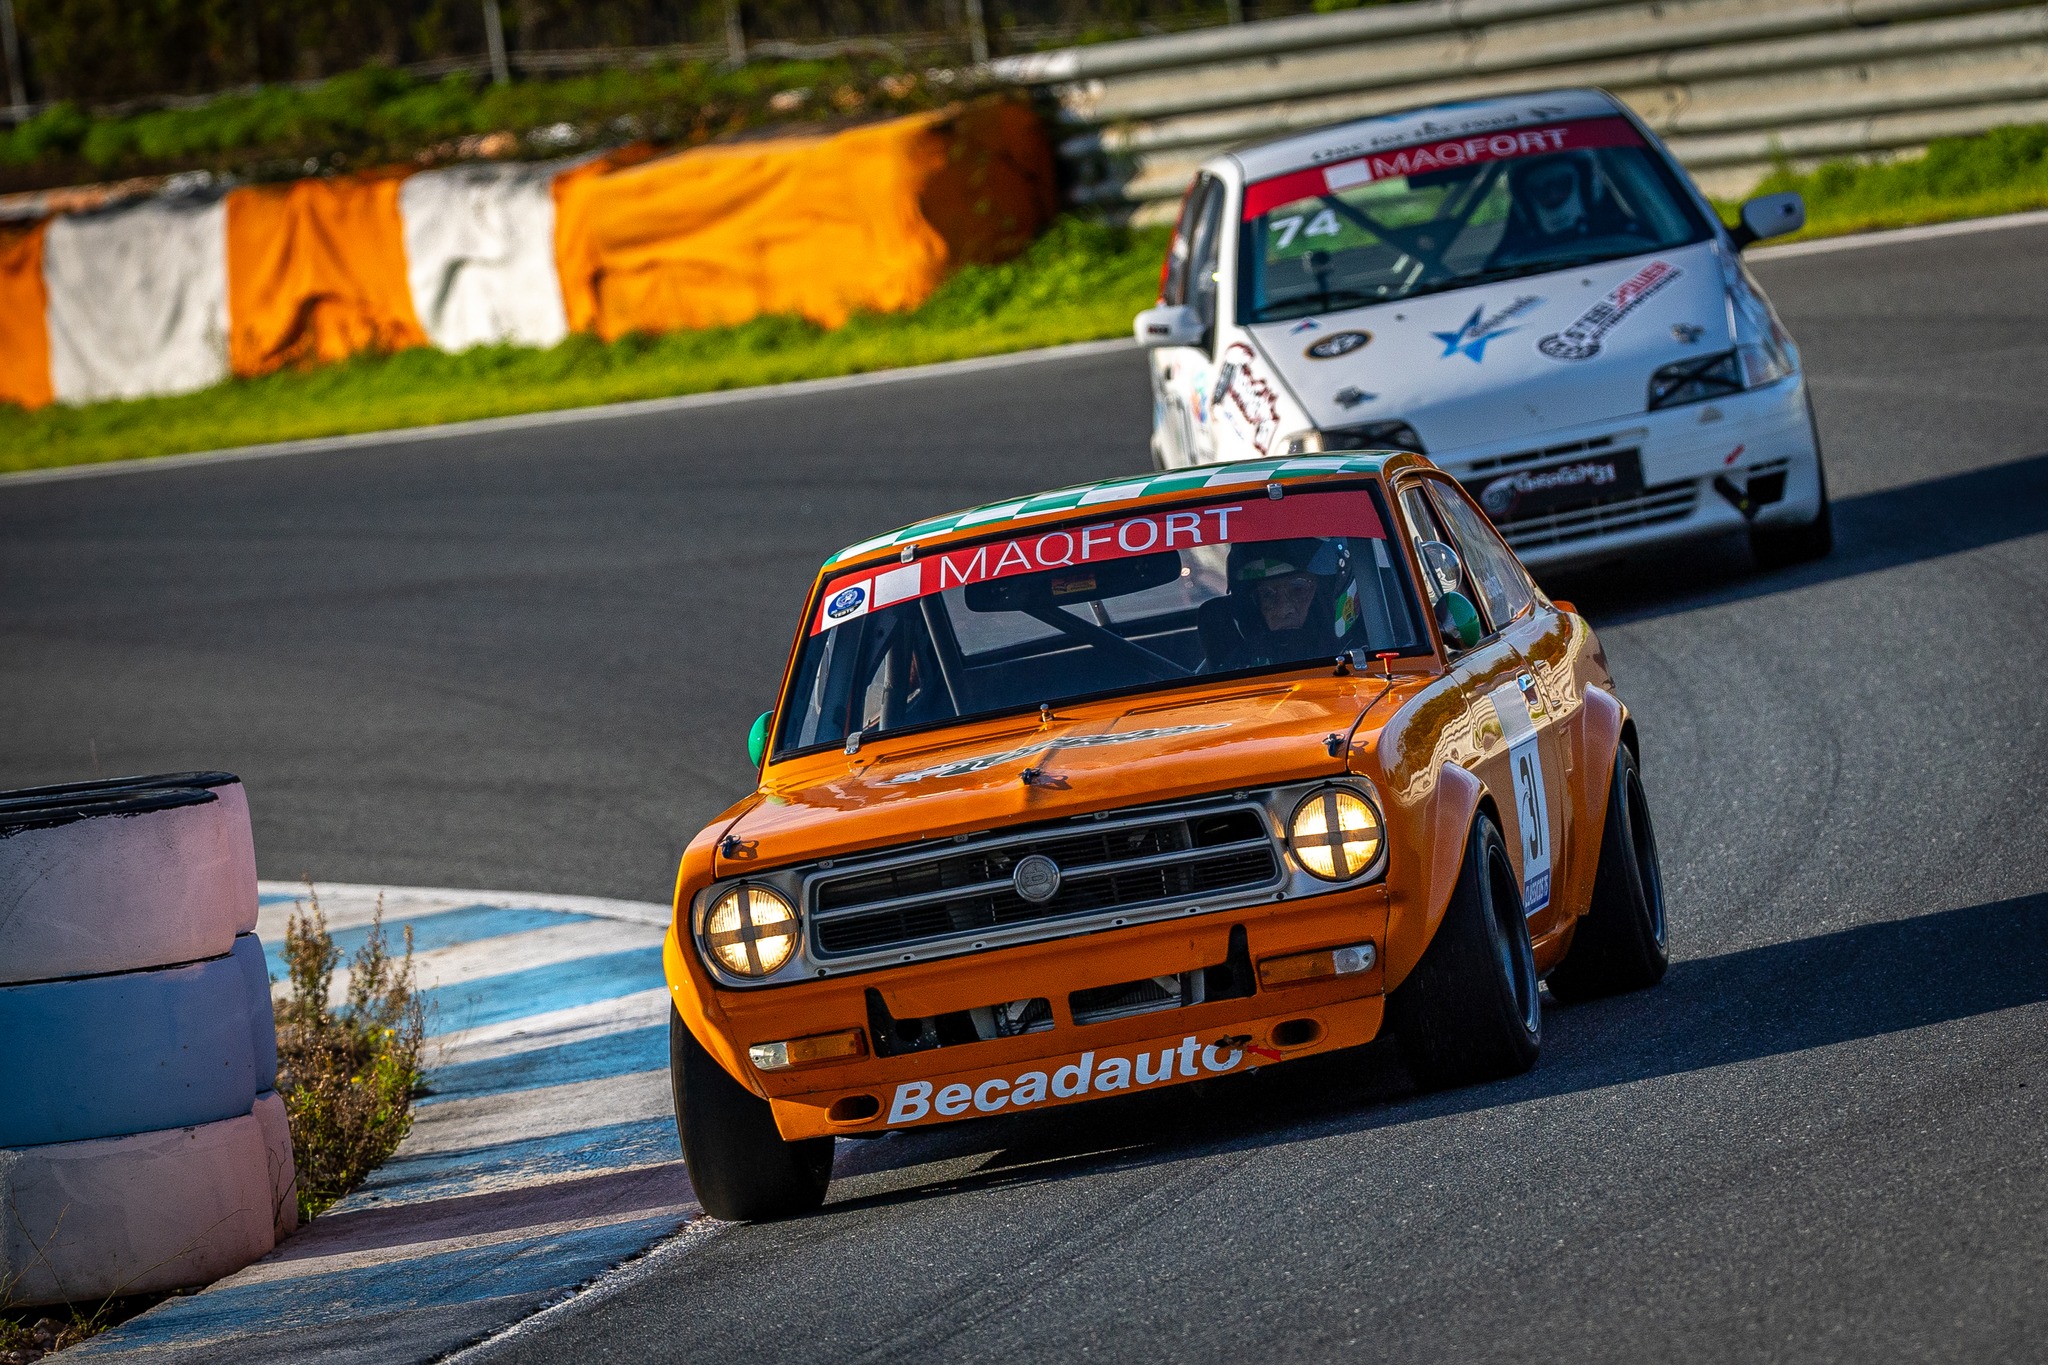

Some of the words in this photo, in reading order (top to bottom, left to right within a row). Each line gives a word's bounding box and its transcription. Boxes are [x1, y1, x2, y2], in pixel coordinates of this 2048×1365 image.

[1373, 128, 1568, 178] MAQFORT
[1269, 208, 1341, 250] 74
[940, 506, 1243, 589] MAQFORT
[1519, 752, 1544, 861] 31
[887, 1035, 1244, 1125] Becadauto
